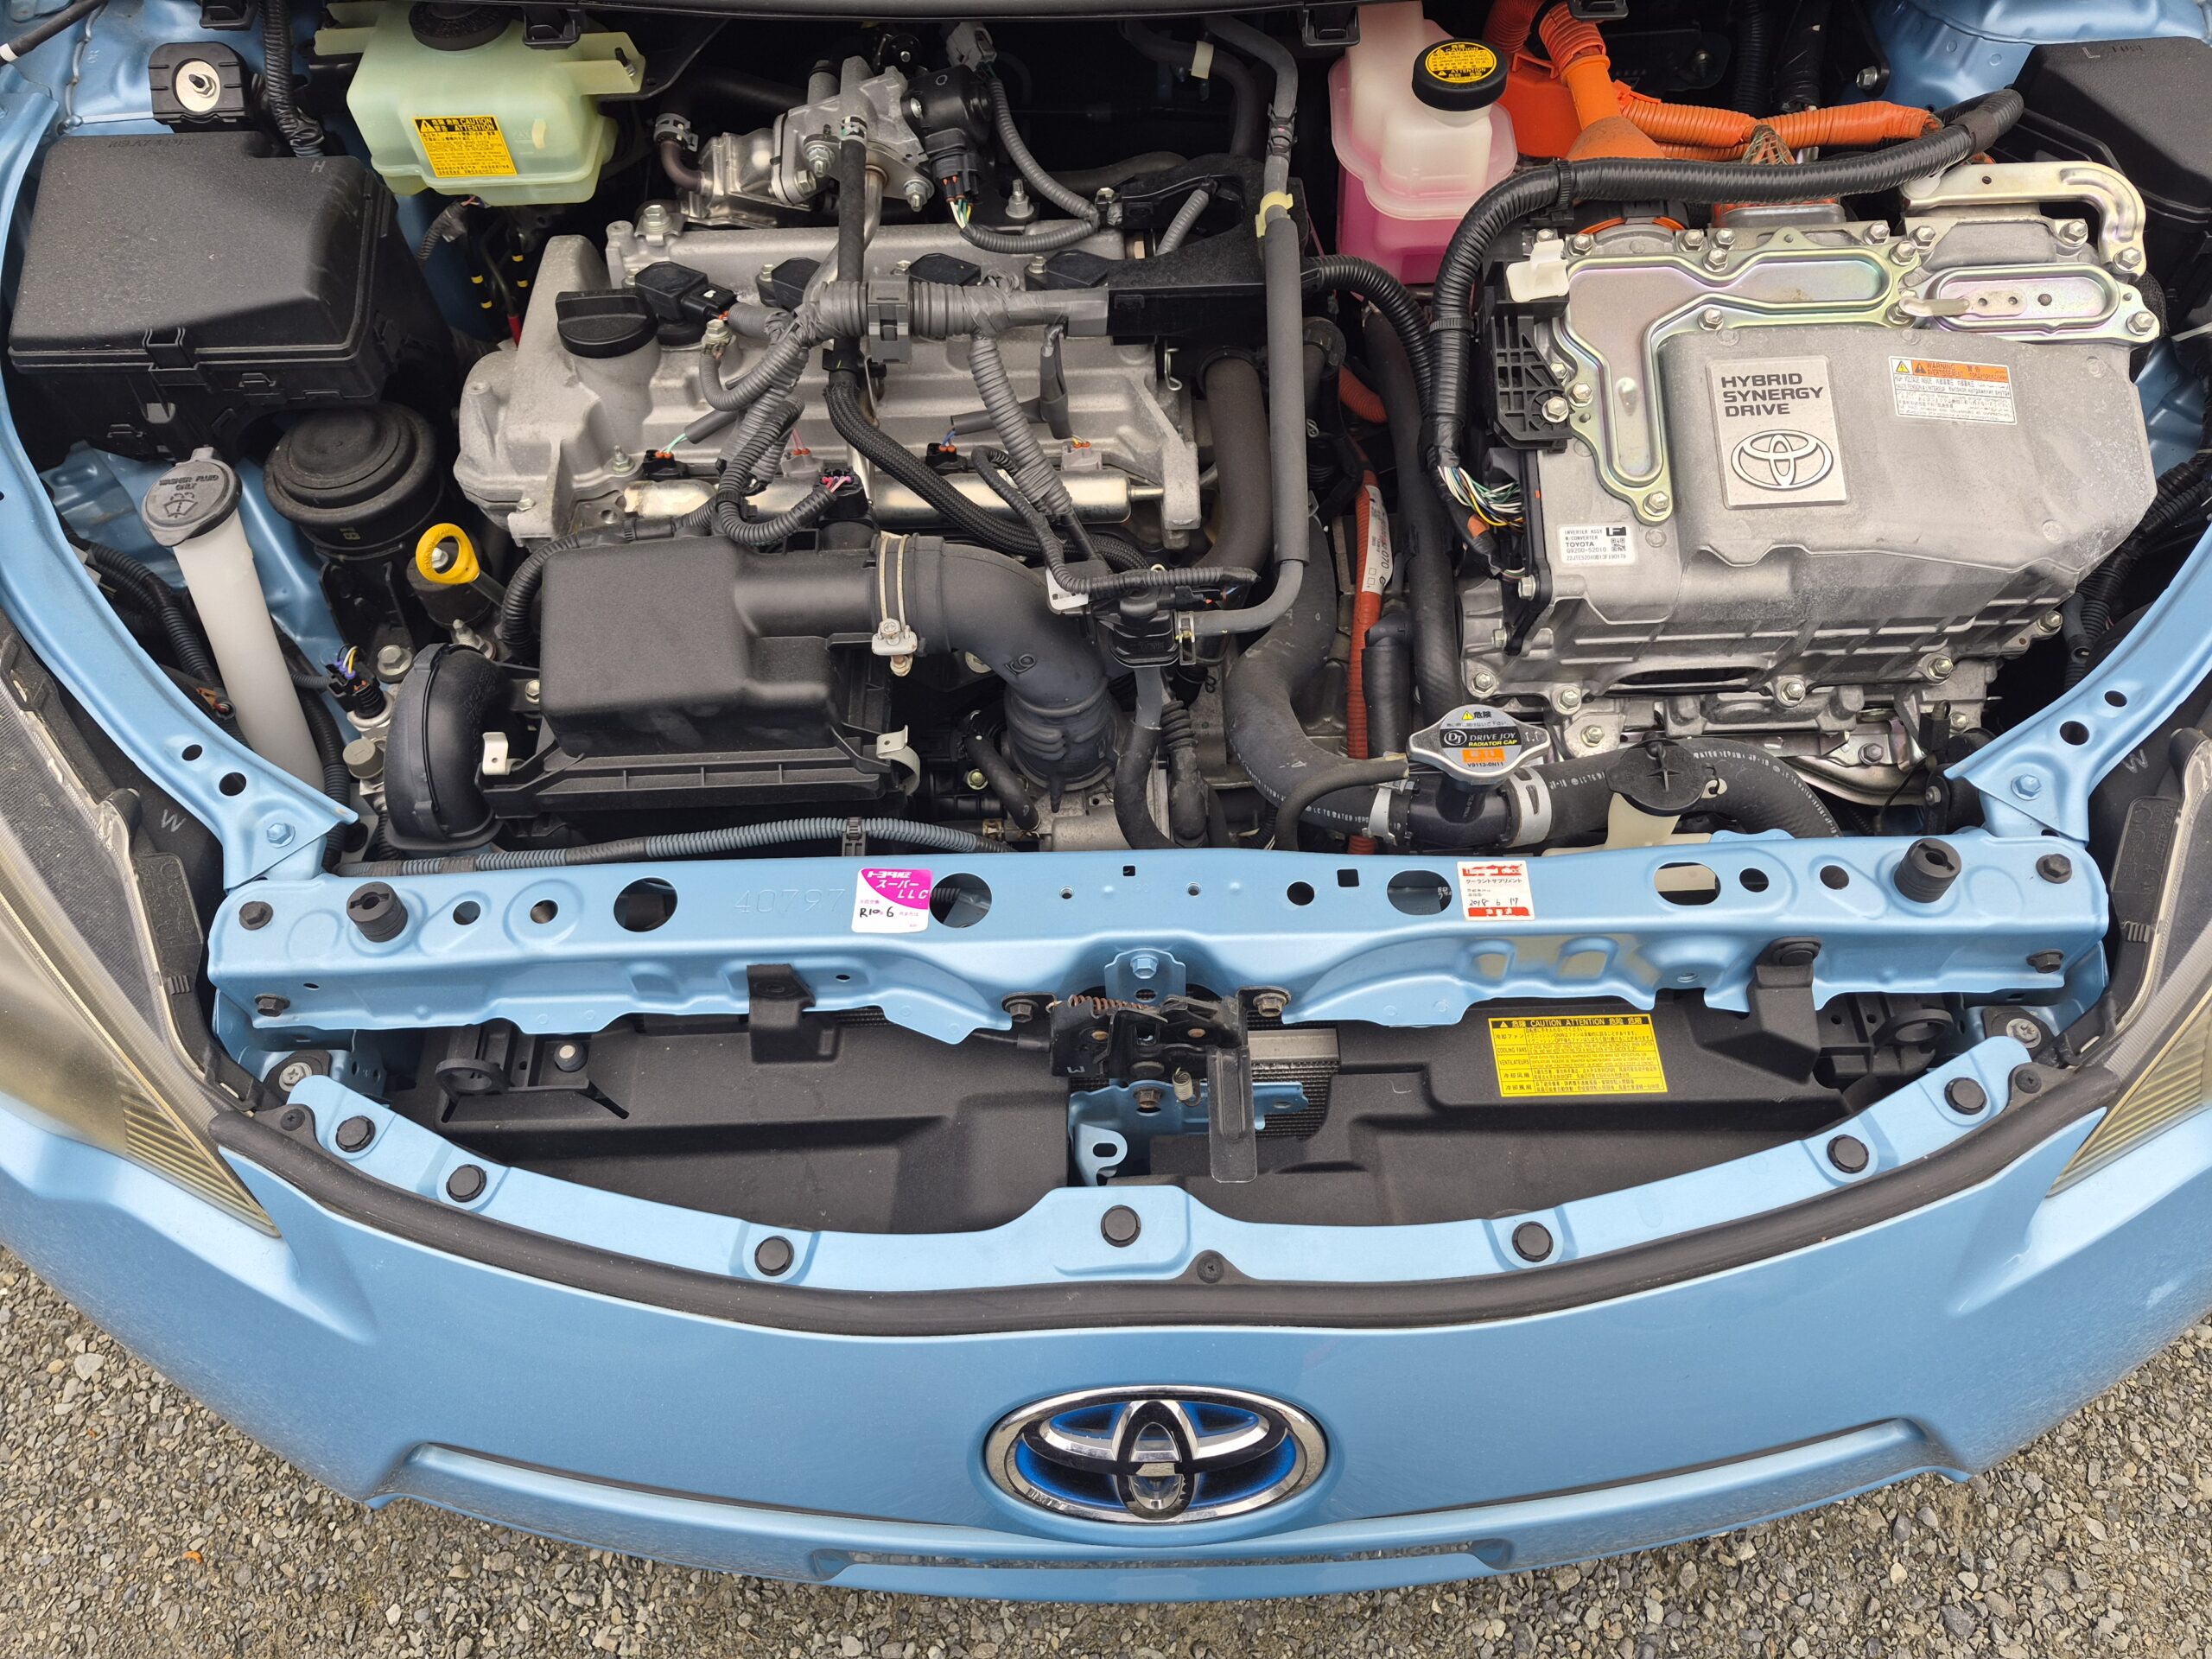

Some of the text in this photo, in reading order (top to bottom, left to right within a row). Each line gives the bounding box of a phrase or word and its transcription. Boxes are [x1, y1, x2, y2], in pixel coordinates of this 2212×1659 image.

[311, 160, 326, 173] H
[1721, 373, 1802, 388] HYBRID
[1723, 387, 1823, 403] SYNERGY
[1725, 403, 1790, 417] DRIVE
[1473, 710, 1492, 719] 危険
[161, 808, 187, 833] W
[1332, 810, 1353, 822] WATER
[875, 880, 920, 889] スーパー
[733, 888, 846, 913] 40797
[887, 906, 894, 918] 6
